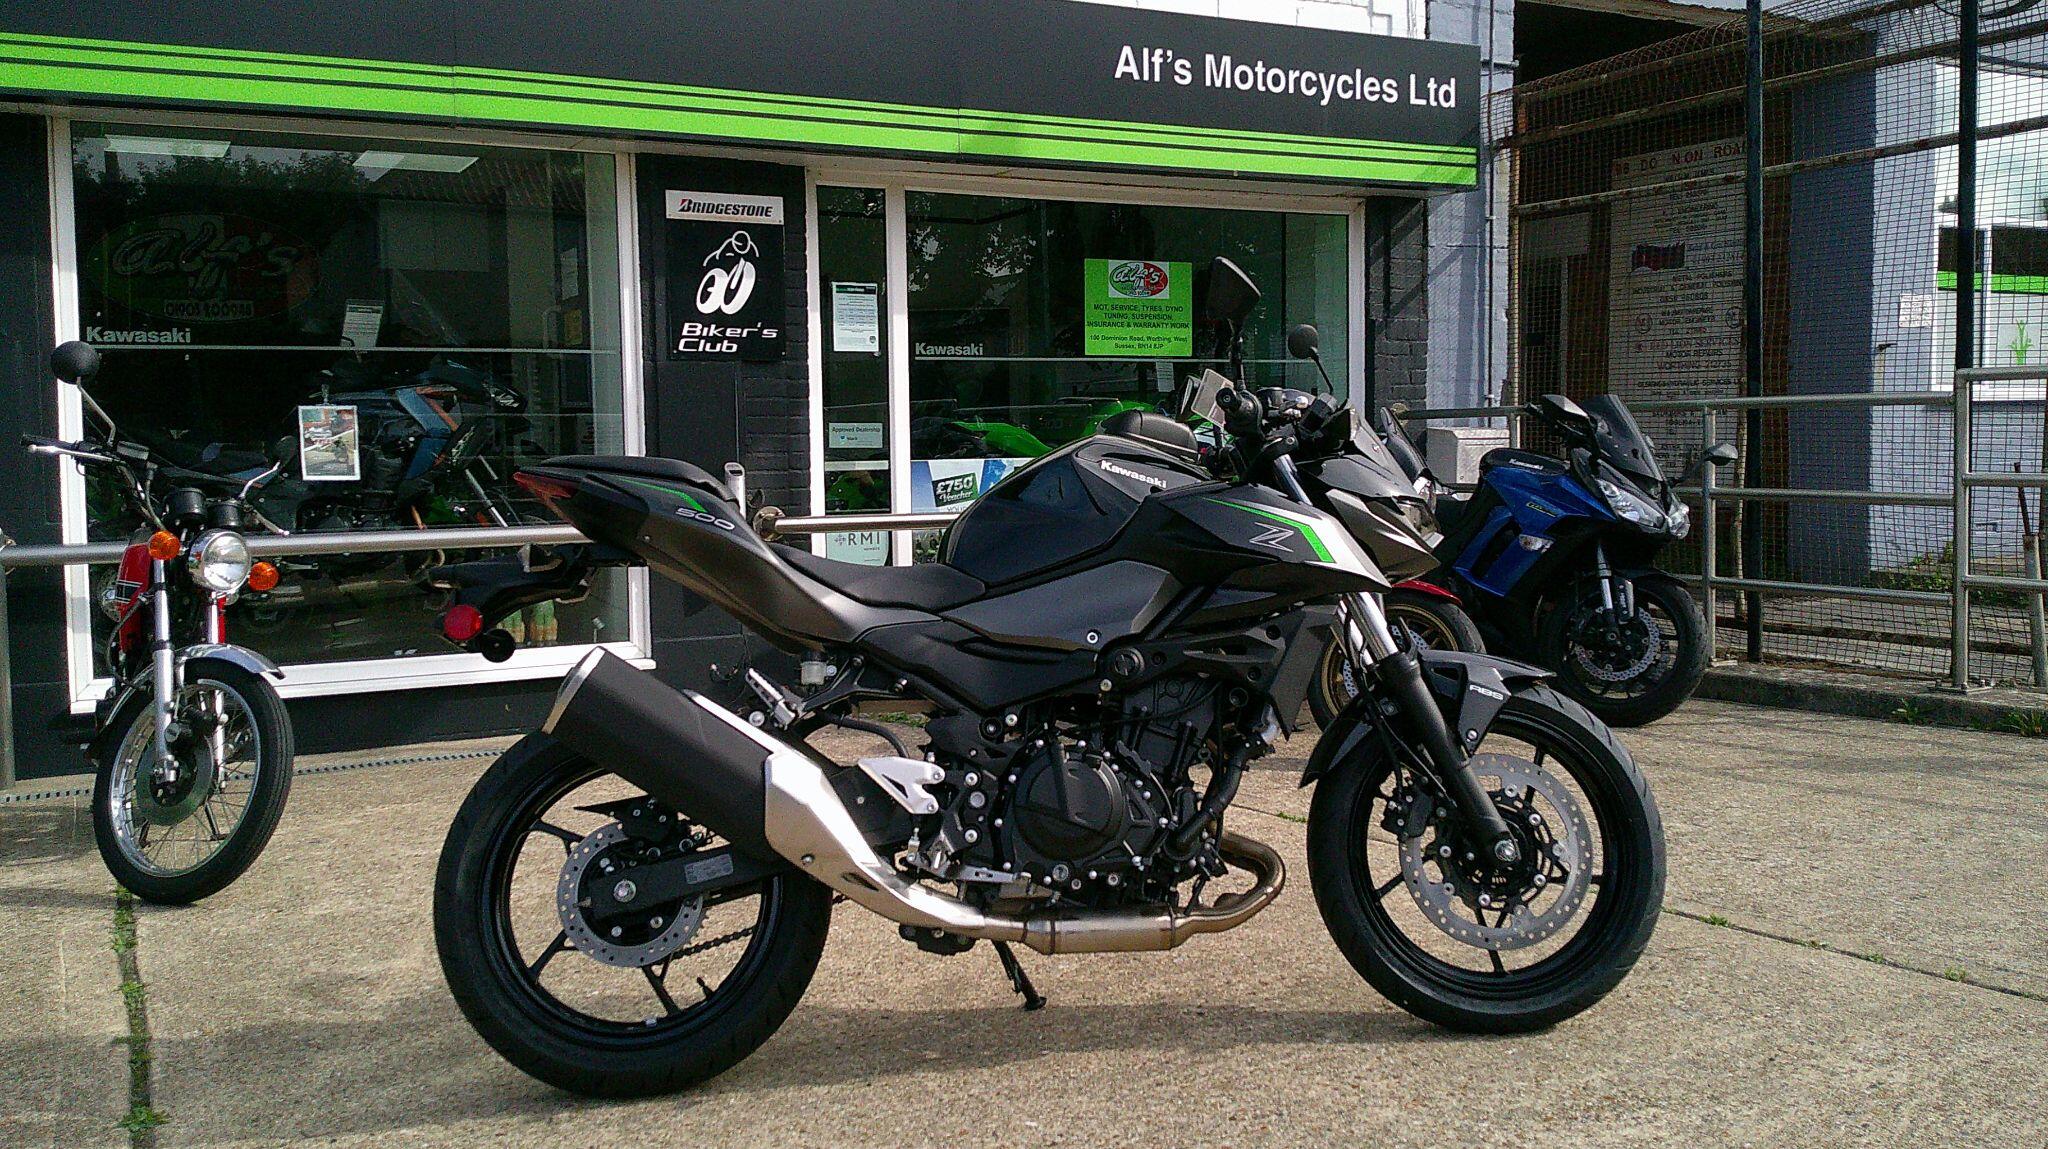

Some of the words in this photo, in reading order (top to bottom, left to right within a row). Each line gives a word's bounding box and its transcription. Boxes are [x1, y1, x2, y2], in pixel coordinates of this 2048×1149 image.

[1114, 45, 1193, 86] Alf's
[1204, 53, 1399, 106] Motorcycles
[1409, 73, 1457, 108] Ltd
[678, 198, 773, 217] BRIDGESTONE
[681, 322, 779, 339] Biker's
[1133, 321, 1168, 329] WARRANTY
[87, 326, 191, 343] Kawasaki
[678, 337, 738, 353] Club
[915, 342, 984, 356] Kawasaki
[1100, 460, 1168, 489] Kawasaki
[936, 475, 974, 495] £750
[939, 490, 974, 503] Voucher
[675, 507, 736, 531] 500
[848, 530, 880, 546] RMI
[1249, 521, 1295, 553] Z
[1469, 684, 1504, 700] ABS
